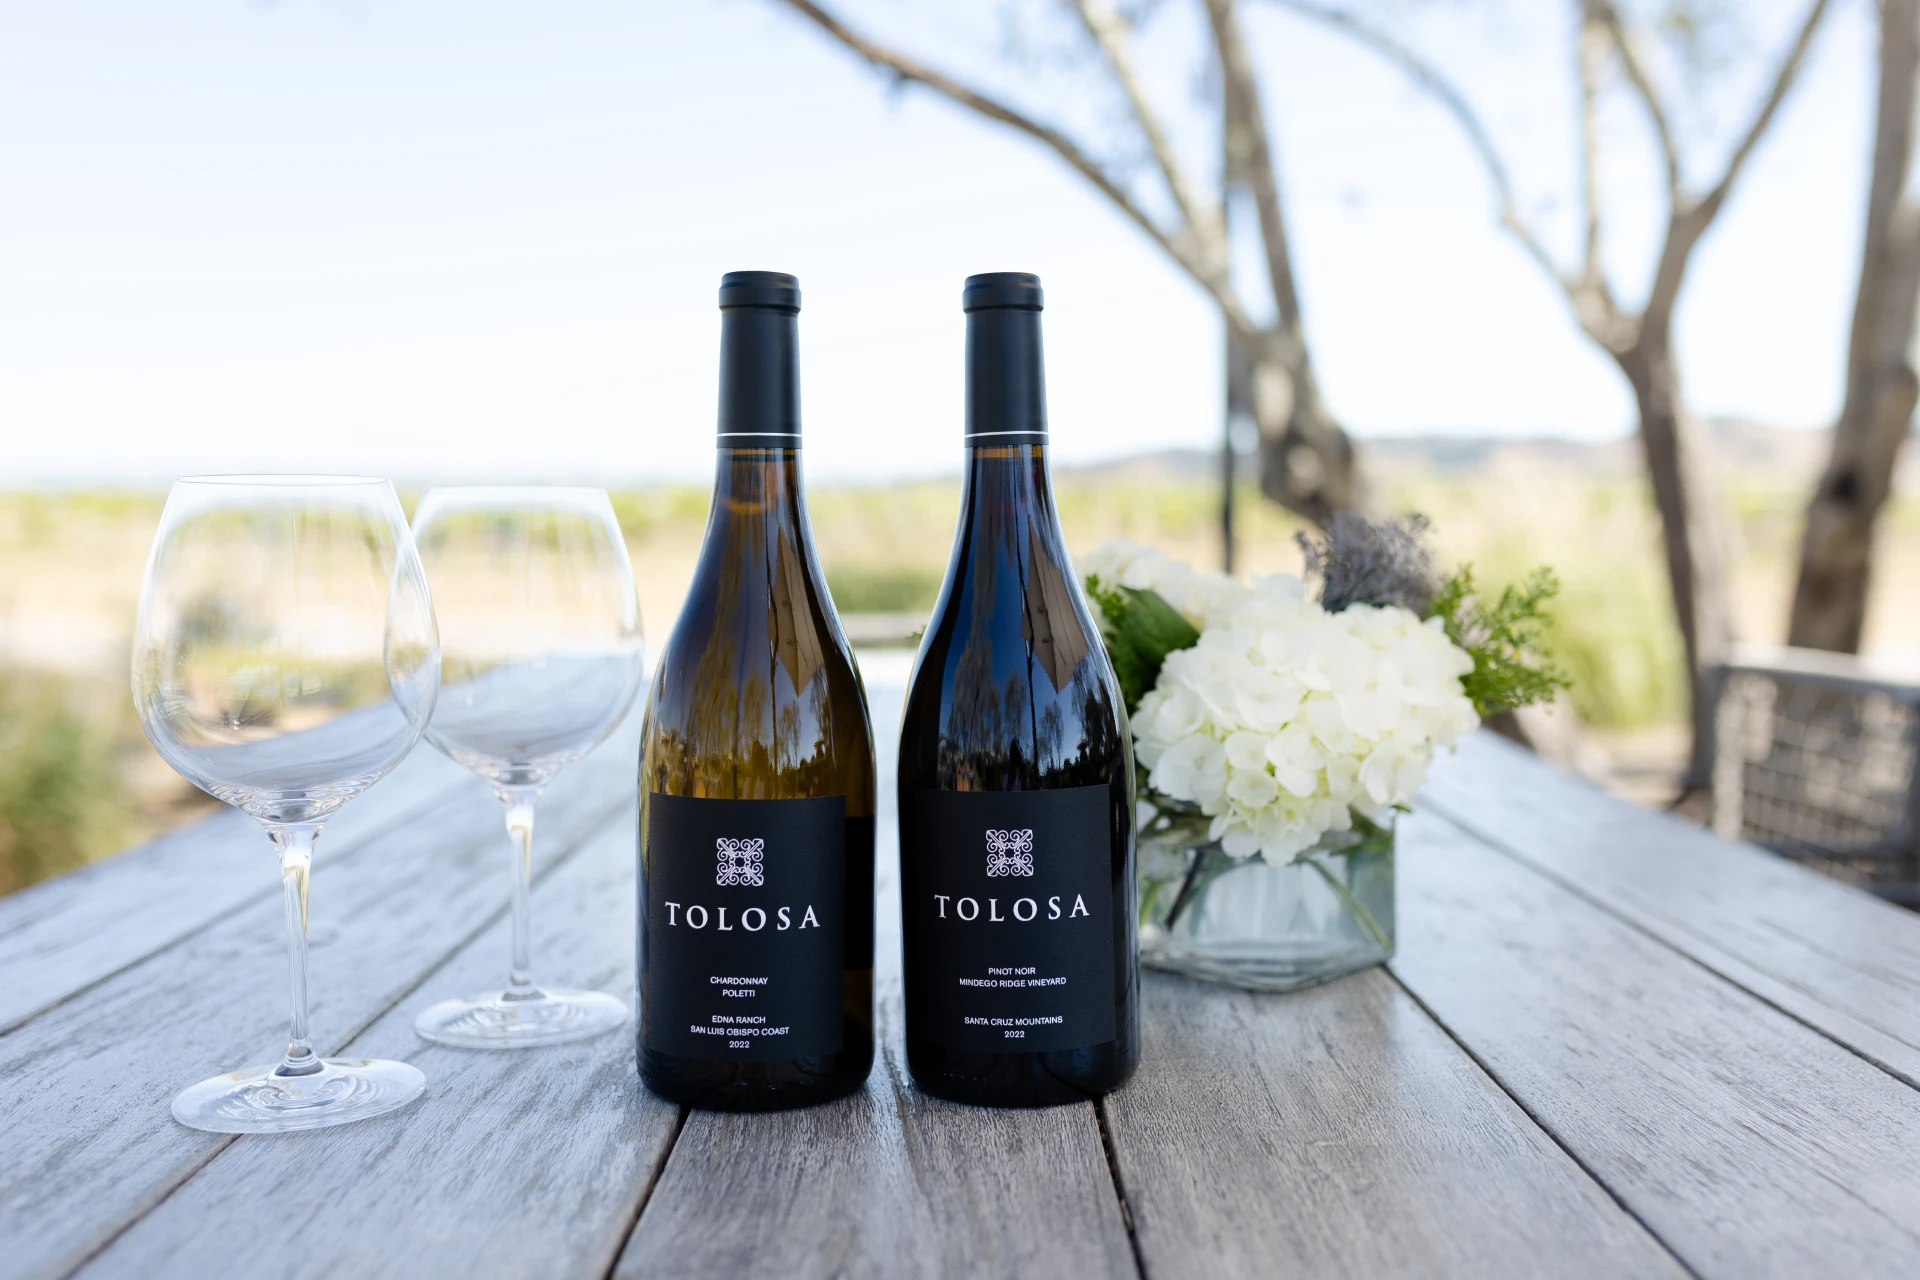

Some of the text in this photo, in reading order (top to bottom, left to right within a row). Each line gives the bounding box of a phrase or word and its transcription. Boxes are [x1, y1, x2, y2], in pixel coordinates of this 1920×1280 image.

[934, 893, 1090, 922] TOLOSA
[665, 901, 820, 931] TOLOSA
[988, 967, 1035, 976] PINOT NOIR
[710, 976, 768, 985] CHARDONNAY
[960, 977, 1066, 988] MINDEGO RIDGE VINEYARD
[722, 990, 755, 998] POLETTI
[712, 1016, 765, 1024] EDNA RANCH
[964, 1016, 1063, 1026] SANTA CRUZ MOUNTAINS
[691, 1025, 789, 1036] SAN LUIS OBISPO COAST
[1005, 1031, 1025, 1039] 2022
[729, 1041, 750, 1049] 2022
